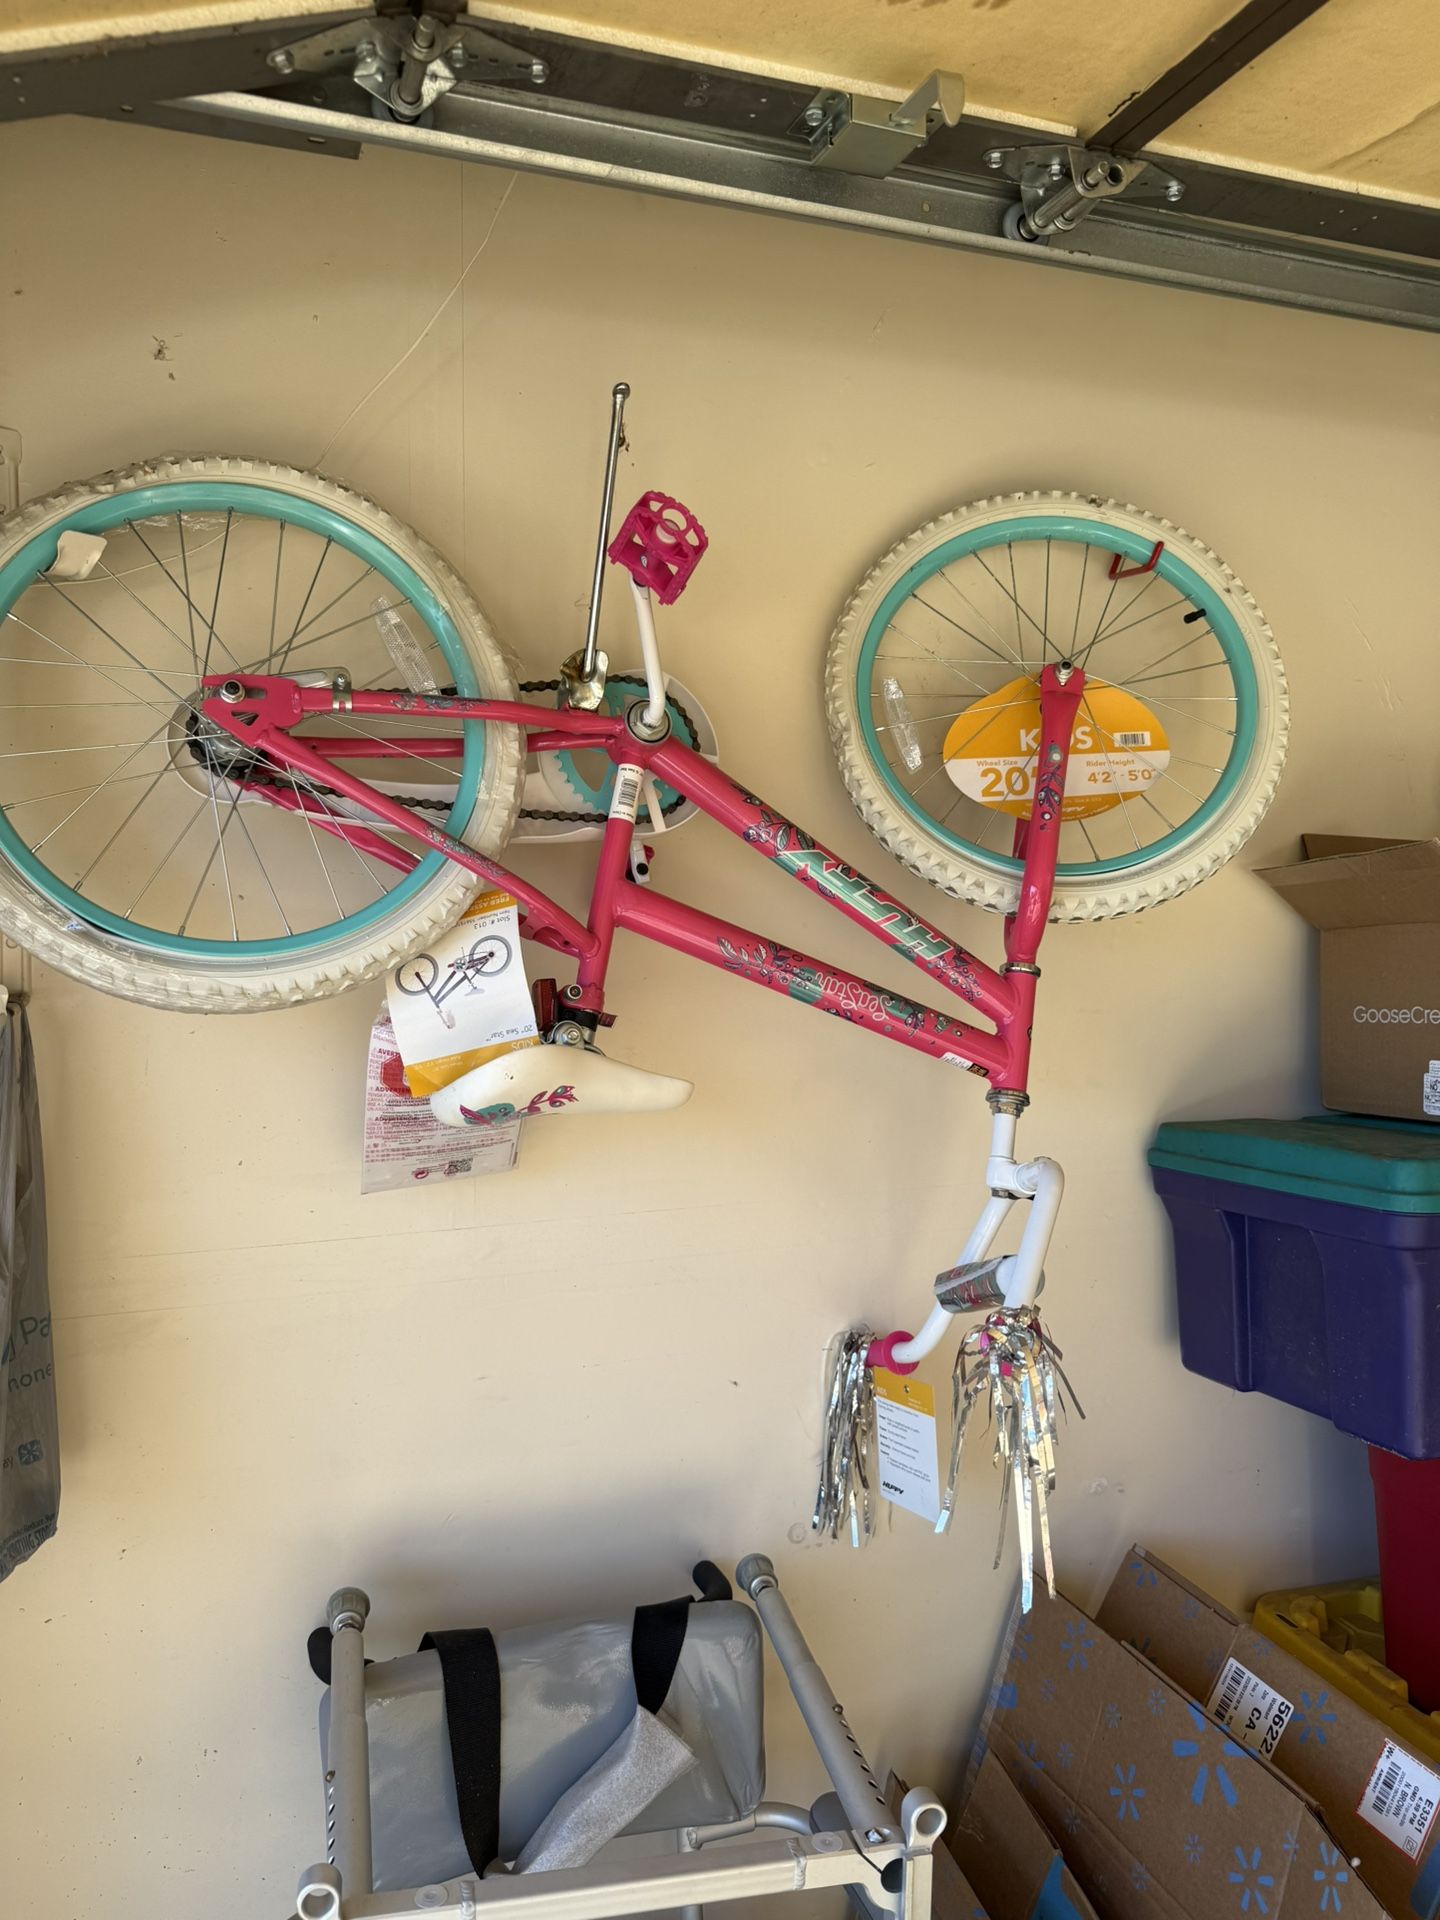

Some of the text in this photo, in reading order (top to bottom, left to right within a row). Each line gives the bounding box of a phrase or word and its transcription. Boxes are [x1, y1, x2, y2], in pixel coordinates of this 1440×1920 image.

[1020, 726, 1093, 752] KS
[1109, 759, 1135, 767] Height
[780, 850, 954, 960] HUFFY
[1353, 1005, 1440, 1024] GooseCre
[1245, 1706, 1262, 1730] CA
[1259, 1701, 1291, 1754] 5622
[1371, 1768, 1384, 1793] AMBIENT
[1409, 1785, 1420, 1801] GMD
[1392, 1790, 1408, 1818] BROWN
[1414, 1798, 1434, 1834] E3351
[1409, 1812, 1418, 1826] PM
